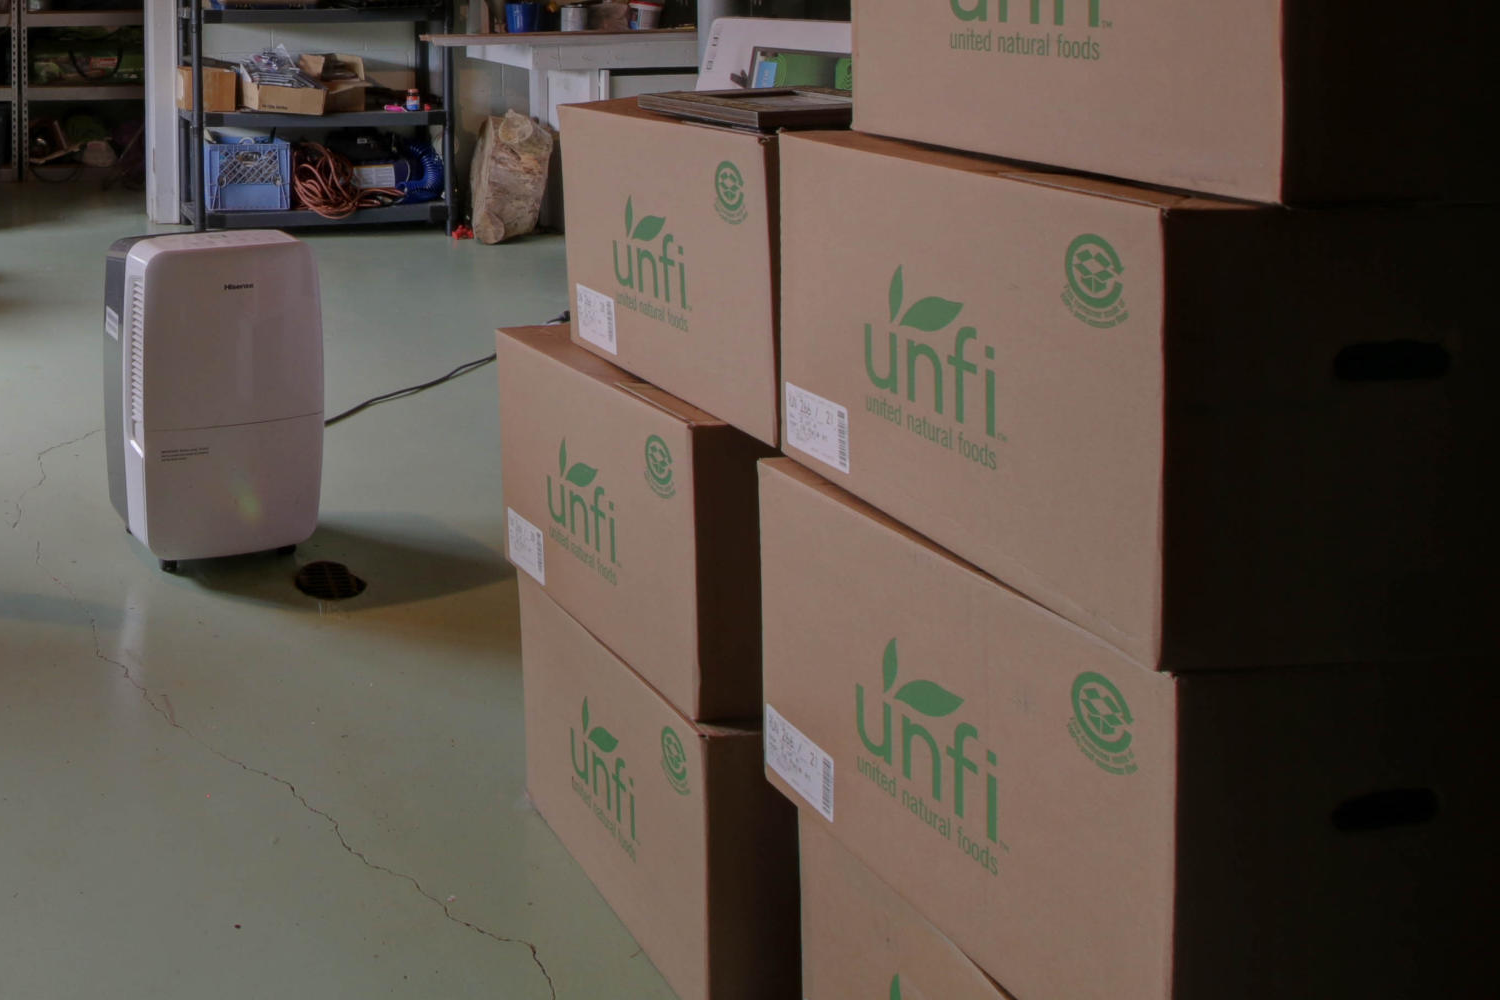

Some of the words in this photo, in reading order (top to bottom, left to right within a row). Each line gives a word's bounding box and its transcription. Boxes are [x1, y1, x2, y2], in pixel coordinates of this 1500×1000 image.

[950, 28, 993, 52] united
[997, 31, 1050, 57] natural
[1056, 33, 1100, 60] foods
[613, 233, 687, 310] unfi
[864, 323, 996, 438] unfi
[866, 394, 902, 427] united
[907, 414, 953, 450] natural
[957, 431, 997, 470] foods
[546, 474, 617, 564] unfi
[570, 727, 636, 841] unfi
[856, 683, 998, 844] unfi
[856, 755, 897, 798] united
[902, 788, 951, 841] natural
[957, 825, 998, 877] foods
